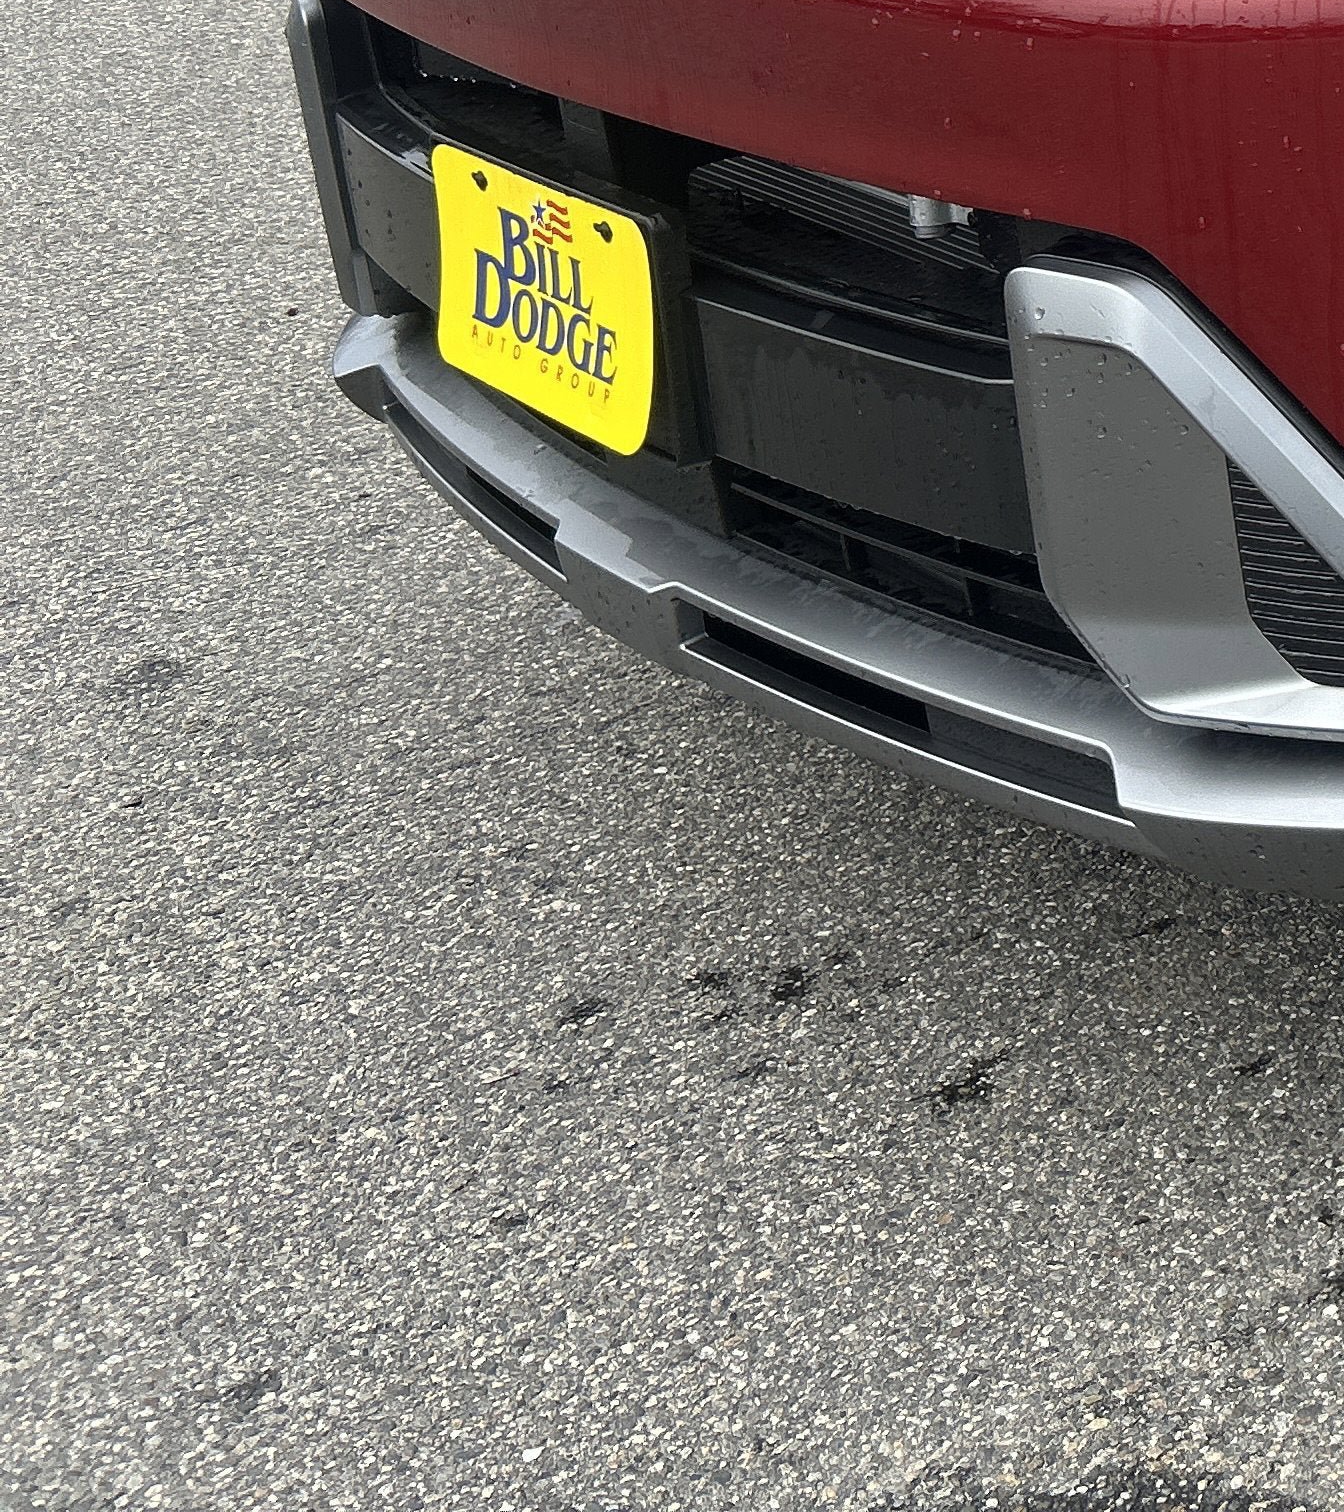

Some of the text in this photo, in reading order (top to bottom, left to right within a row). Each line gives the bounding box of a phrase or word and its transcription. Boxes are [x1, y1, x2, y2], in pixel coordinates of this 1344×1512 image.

[497, 206, 594, 316] BILL
[472, 248, 618, 385] DODGE
[472, 324, 611, 403] AUTO GROUP
